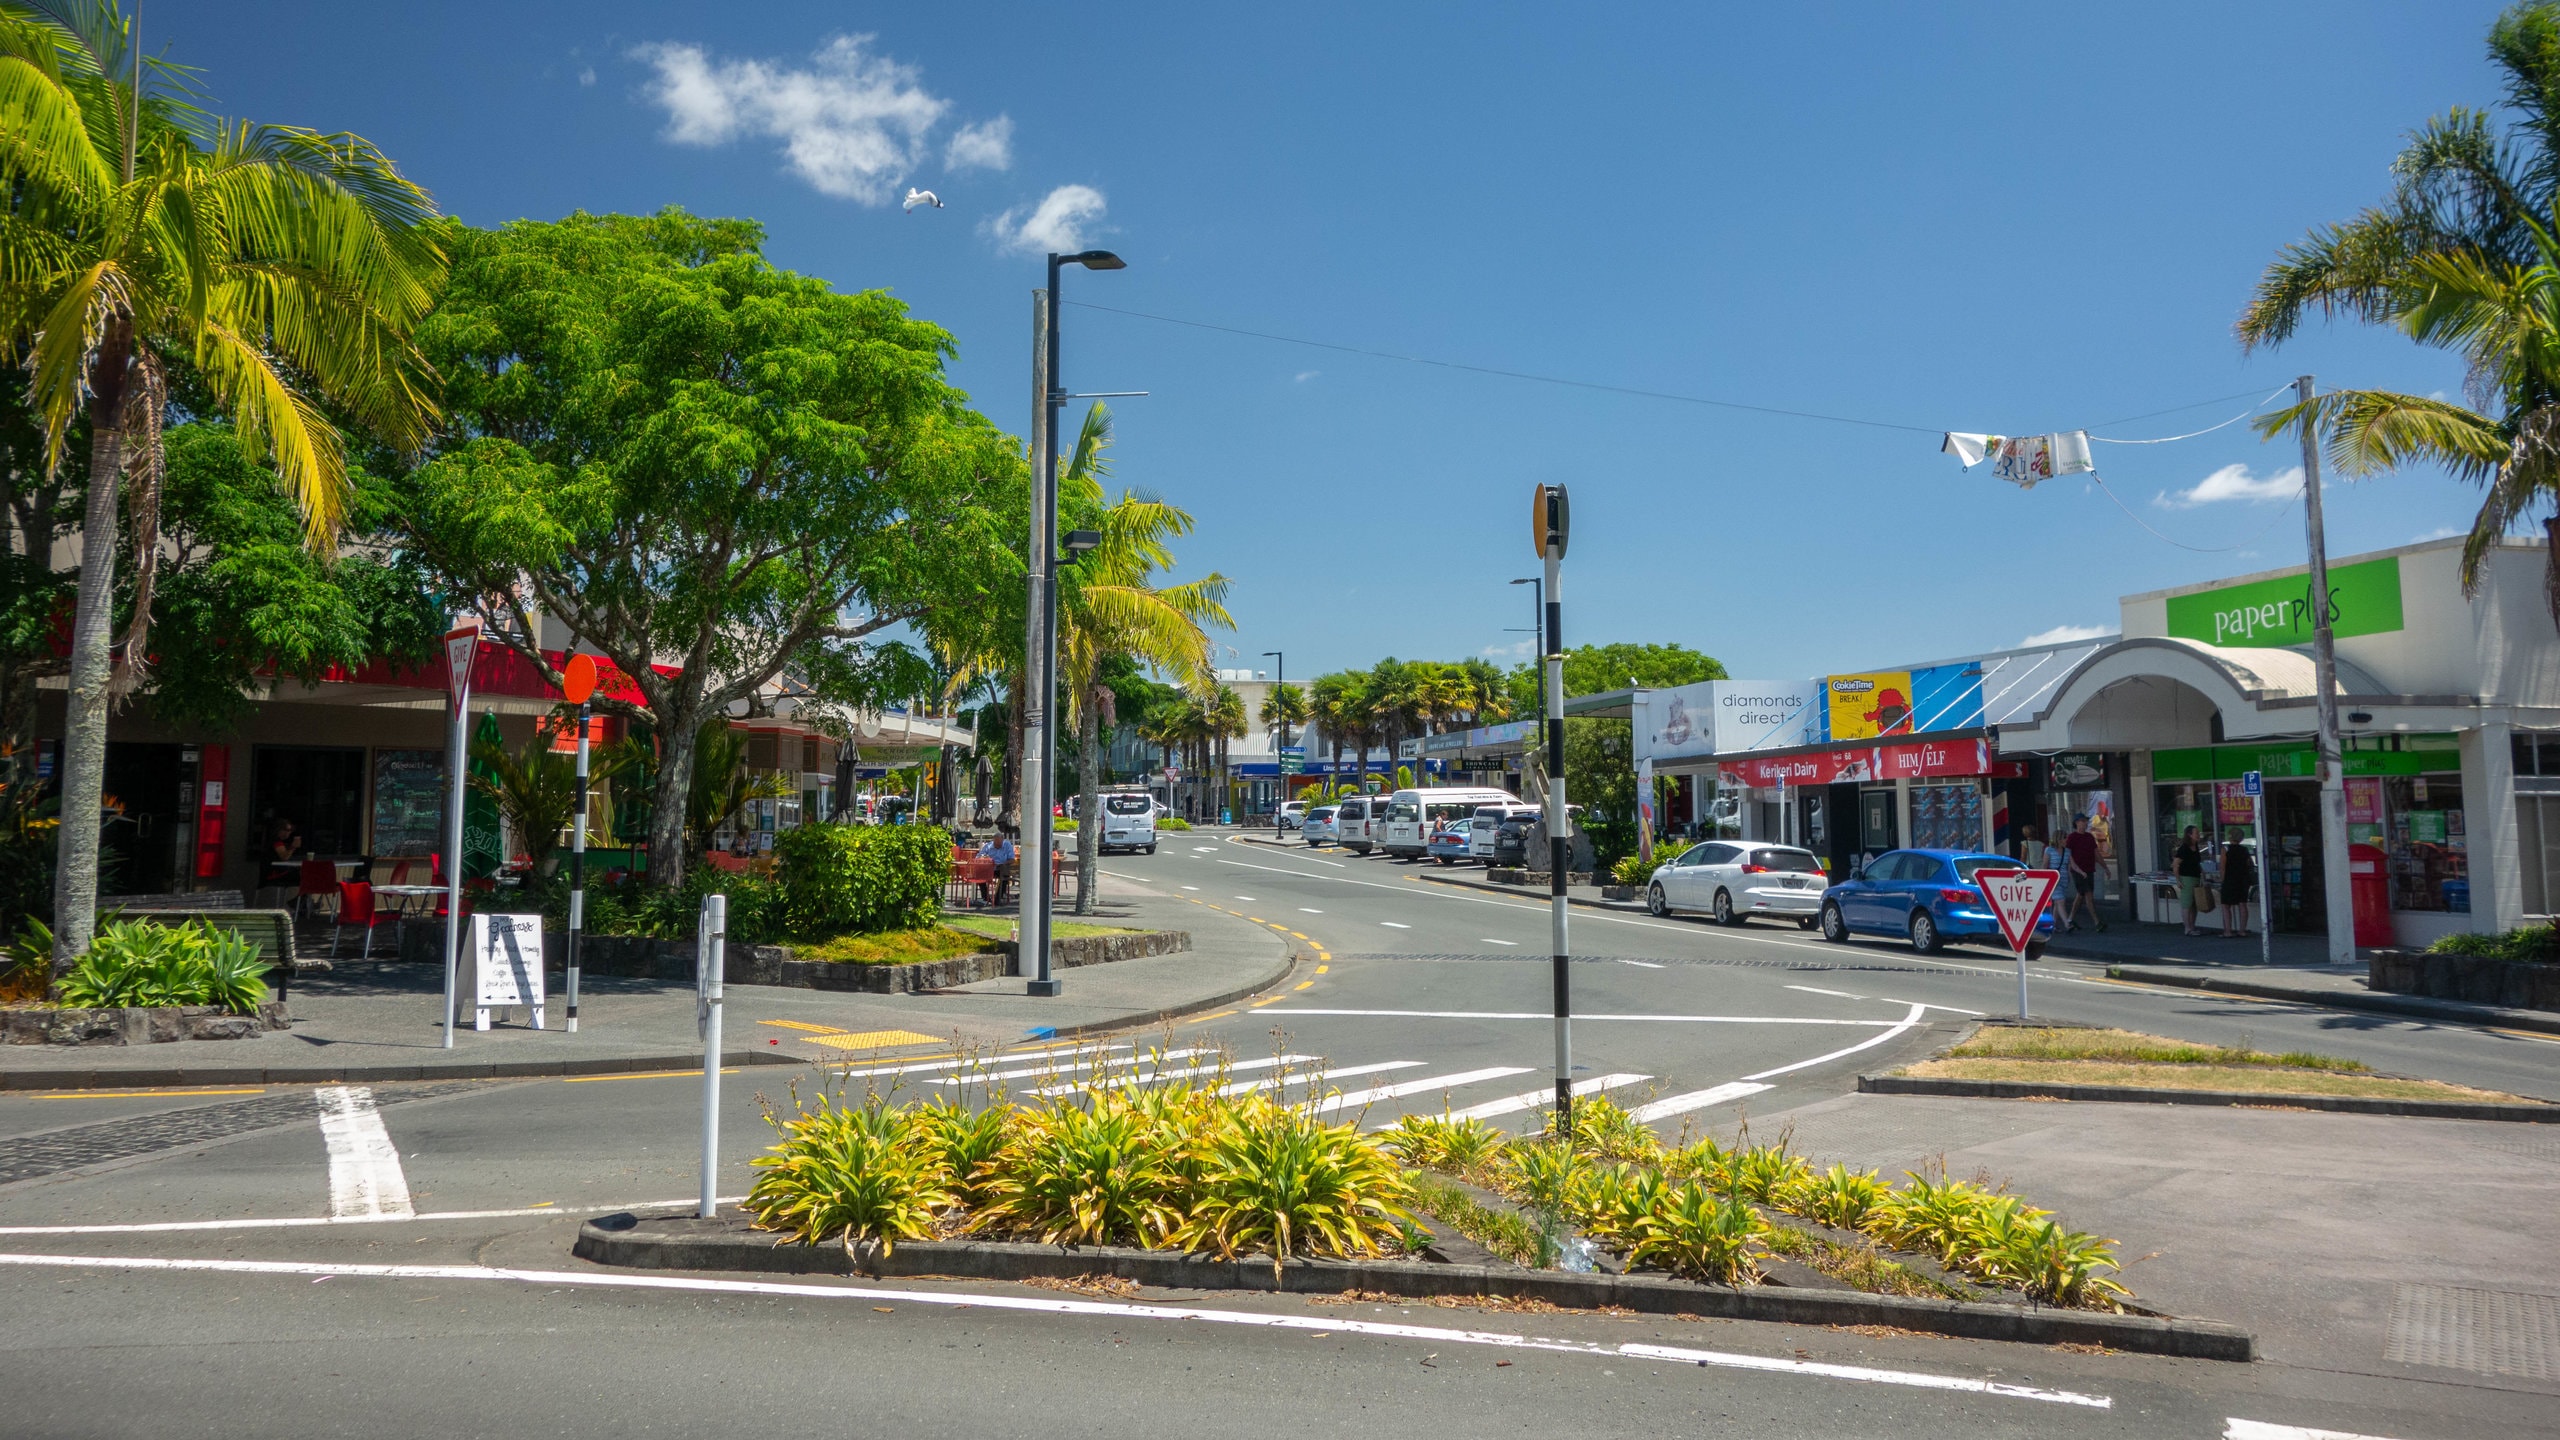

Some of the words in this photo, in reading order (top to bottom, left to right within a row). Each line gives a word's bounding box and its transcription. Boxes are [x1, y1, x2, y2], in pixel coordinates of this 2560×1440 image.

[454, 643, 467, 664] GIVE
[456, 671, 464, 686] WAY
[1722, 694, 1802, 707] diamonds
[1840, 694, 1862, 703] BREAK!
[1739, 711, 1786, 725] direct
[1844, 752, 1852, 760] 68
[2258, 752, 2291, 772] pape
[1760, 763, 1792, 779] Kerikeri
[1794, 762, 1818, 778] Dairy
[2249, 774, 2255, 783] P
[2220, 786, 2228, 797] 2
[2230, 786, 2245, 797] DA
[2248, 783, 2257, 791] 120
[2221, 797, 2252, 811] SALE
[2000, 885, 2033, 902] GIVE
[2006, 908, 2027, 922] WAY
[487, 917, 535, 941] Goodness
